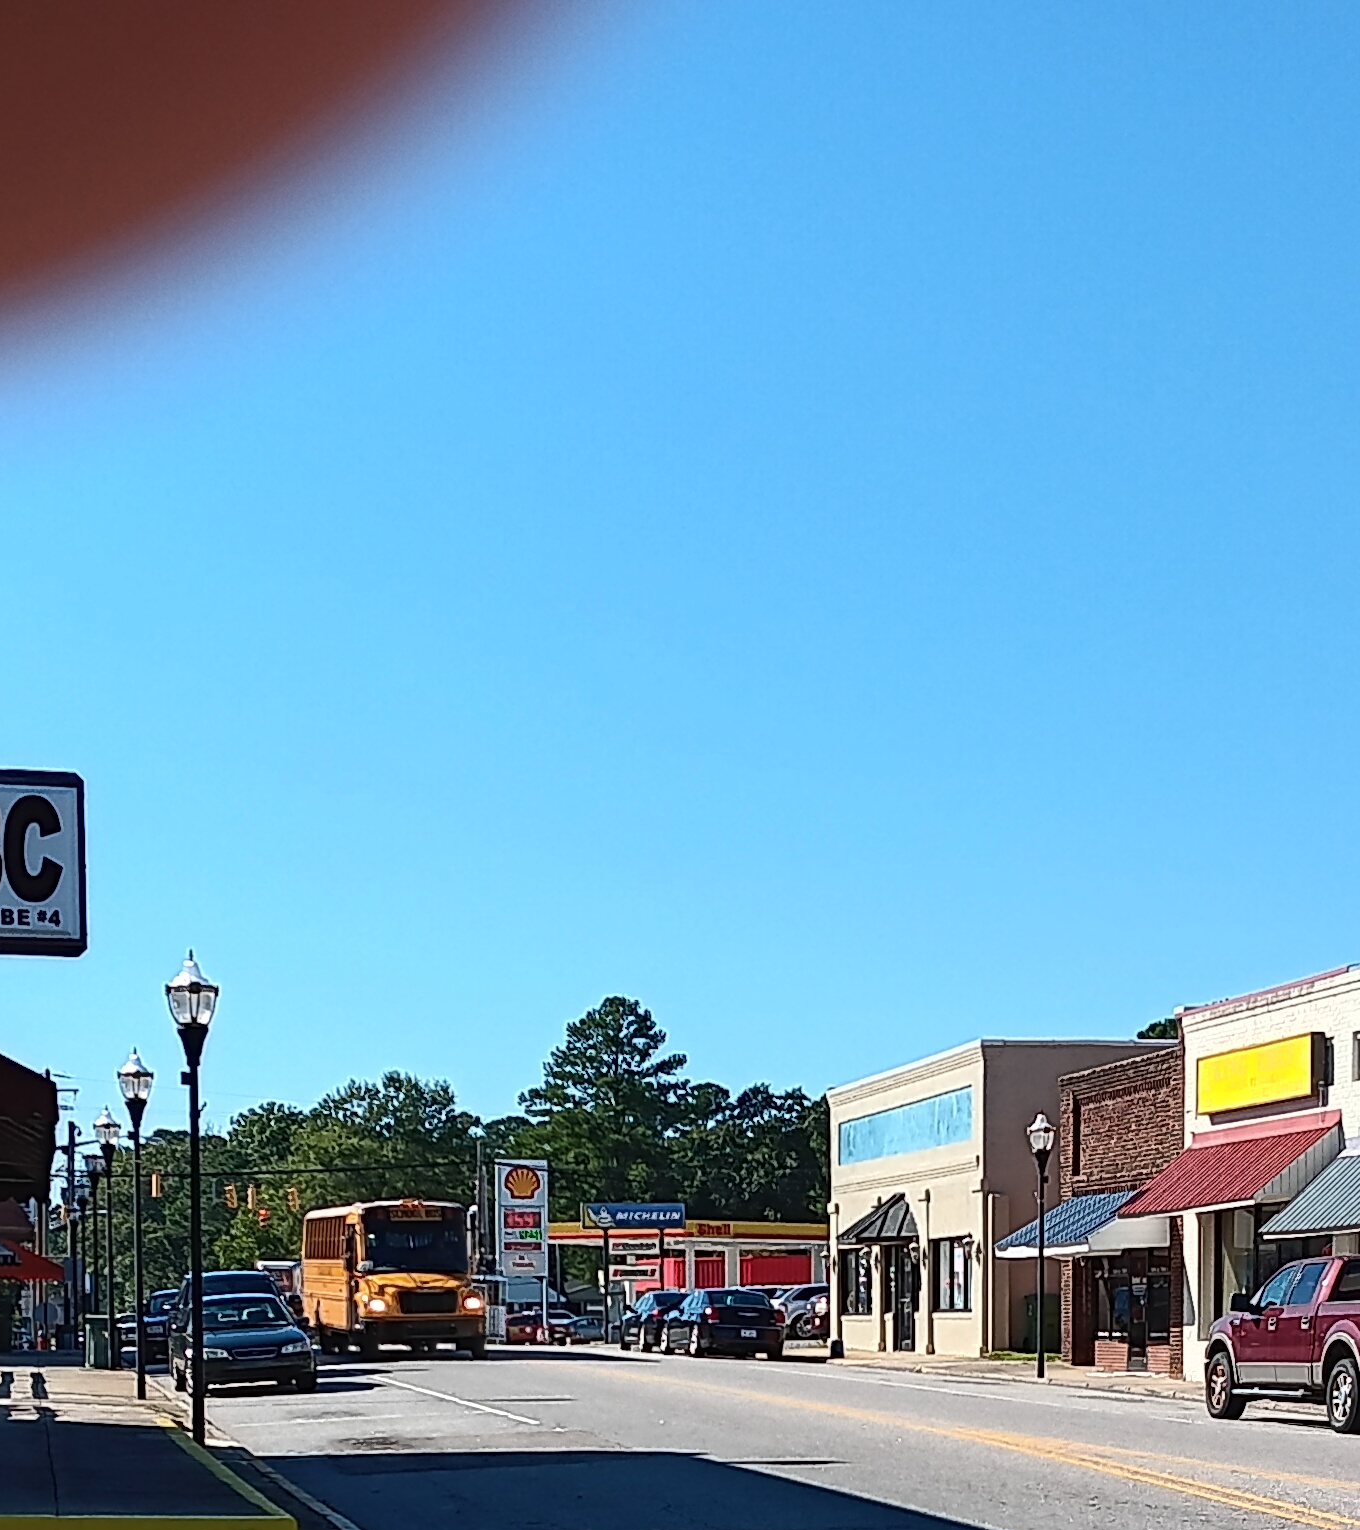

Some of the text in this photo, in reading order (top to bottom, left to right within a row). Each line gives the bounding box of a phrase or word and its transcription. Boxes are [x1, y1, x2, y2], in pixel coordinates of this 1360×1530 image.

[36, 909, 61, 927] #4
[615, 1211, 681, 1221] MICHELIN
[696, 1223, 731, 1236] Shell
